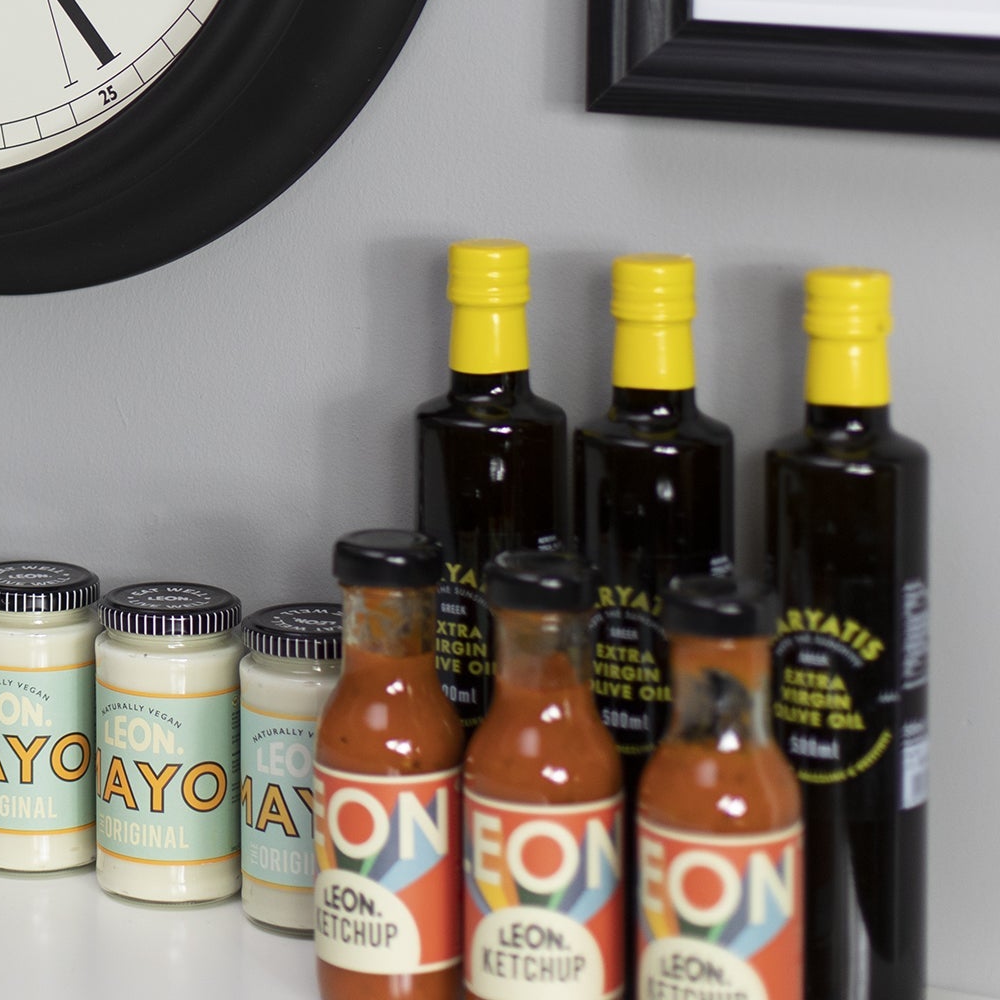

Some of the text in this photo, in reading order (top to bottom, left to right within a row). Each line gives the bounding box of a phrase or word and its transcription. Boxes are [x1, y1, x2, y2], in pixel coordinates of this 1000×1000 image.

[98, 84, 118, 105] 25
[21, 565, 63, 574] WELL
[440, 562, 487, 592] YA
[131, 587, 208, 597] EAT WELL
[440, 602, 467, 615] GREEK
[436, 619, 483, 639] XTRA
[775, 608, 885, 661] ARYATIS
[435, 637, 488, 658] IRGIN
[596, 643, 656, 664] EXTRA
[435, 655, 462, 673] IVE
[593, 661, 661, 683] VIRGIN
[784, 667, 847, 691] EXTRA
[17, 682, 50, 702] VEGAN
[639, 685, 673, 702] OIL
[781, 685, 853, 710] VIRGIN
[101, 703, 182, 729] NATURALLY VEGAN
[602, 708, 649, 730] 500ml
[827, 711, 866, 730] OIL
[104, 715, 185, 756] LEON.
[252, 728, 304, 743] NATURALLY
[256, 741, 312, 778] LEO
[96, 747, 228, 813] AYO
[314, 779, 449, 860] EON
[105, 815, 189, 849] ORIGINAL
[464, 810, 623, 895] EON
[638, 837, 795, 927] EON
[323, 884, 383, 916] LEON.
[498, 922, 571, 950] LEON.
[483, 947, 586, 983] KETCHUP
[660, 953, 732, 987] LEON.
